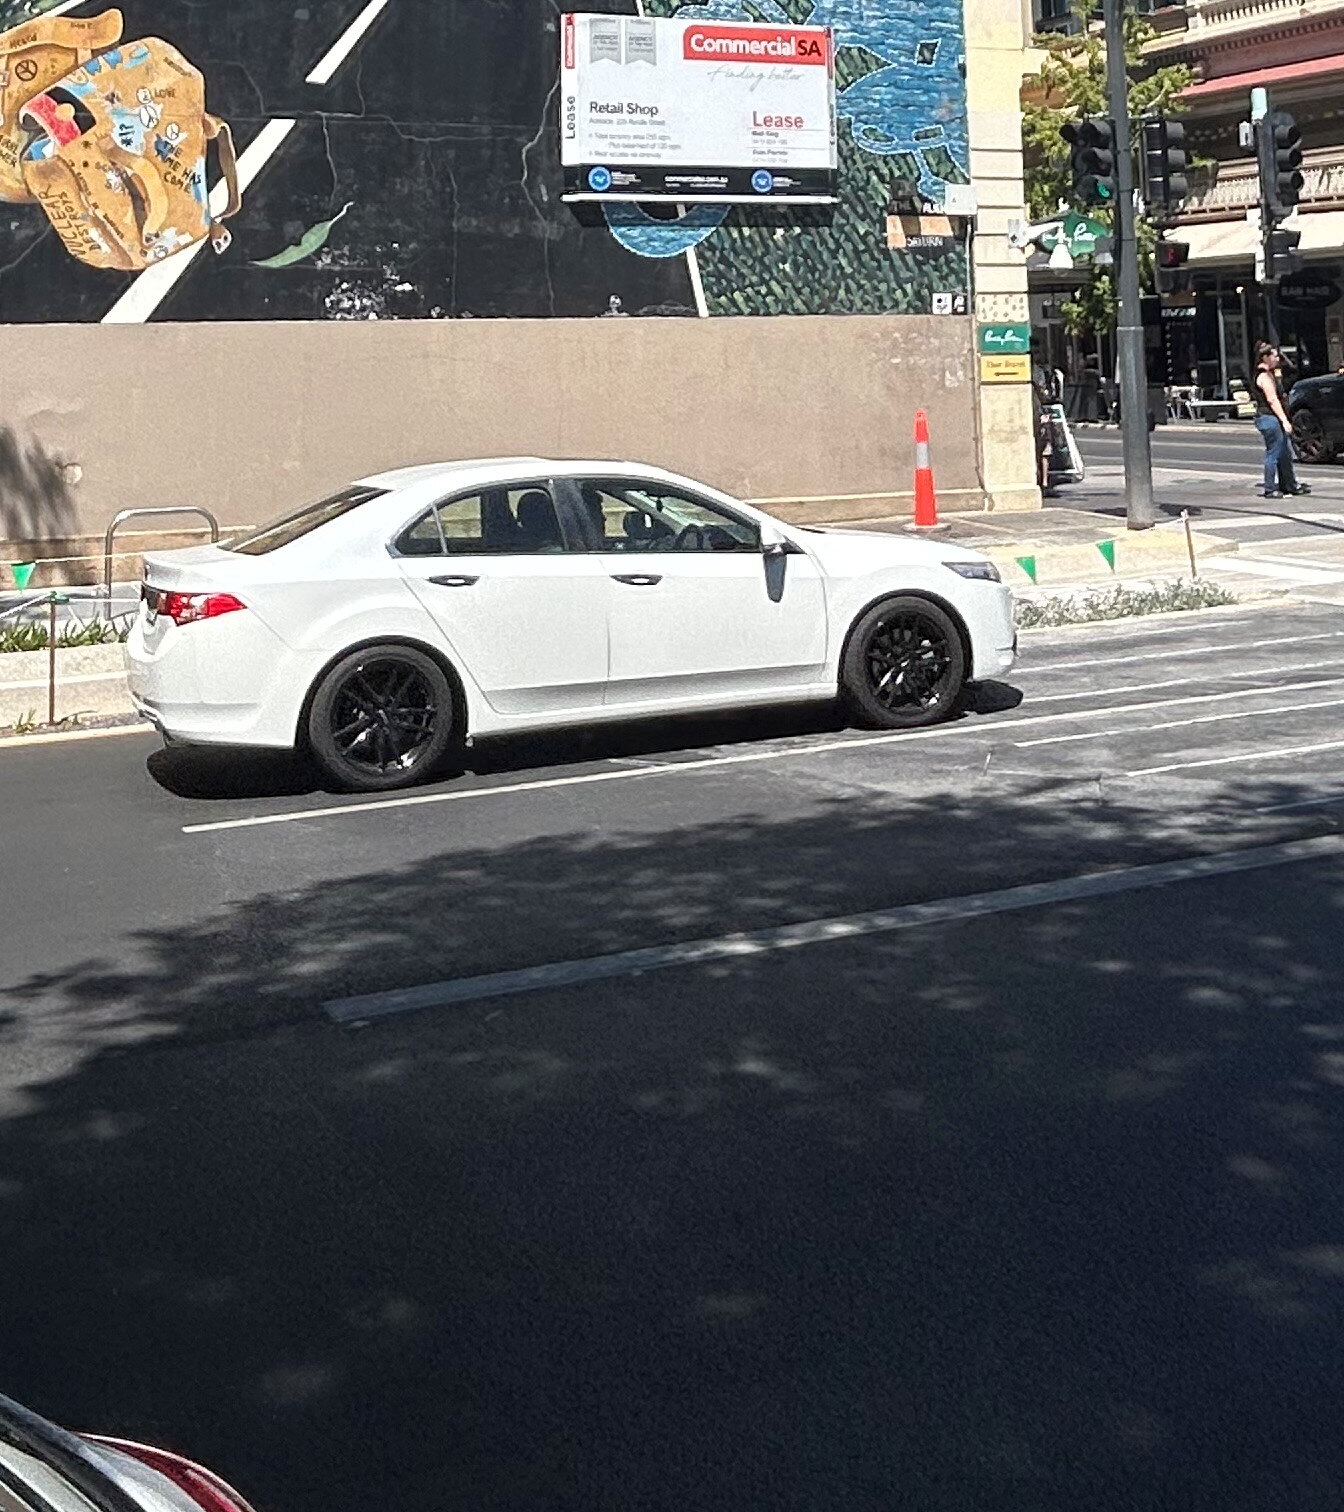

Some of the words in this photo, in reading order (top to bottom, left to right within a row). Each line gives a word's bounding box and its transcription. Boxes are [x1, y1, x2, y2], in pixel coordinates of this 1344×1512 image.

[589, 101, 624, 114] Retail
[627, 102, 659, 117] Shop
[565, 96, 577, 140] Lease
[752, 111, 805, 128] Lease
